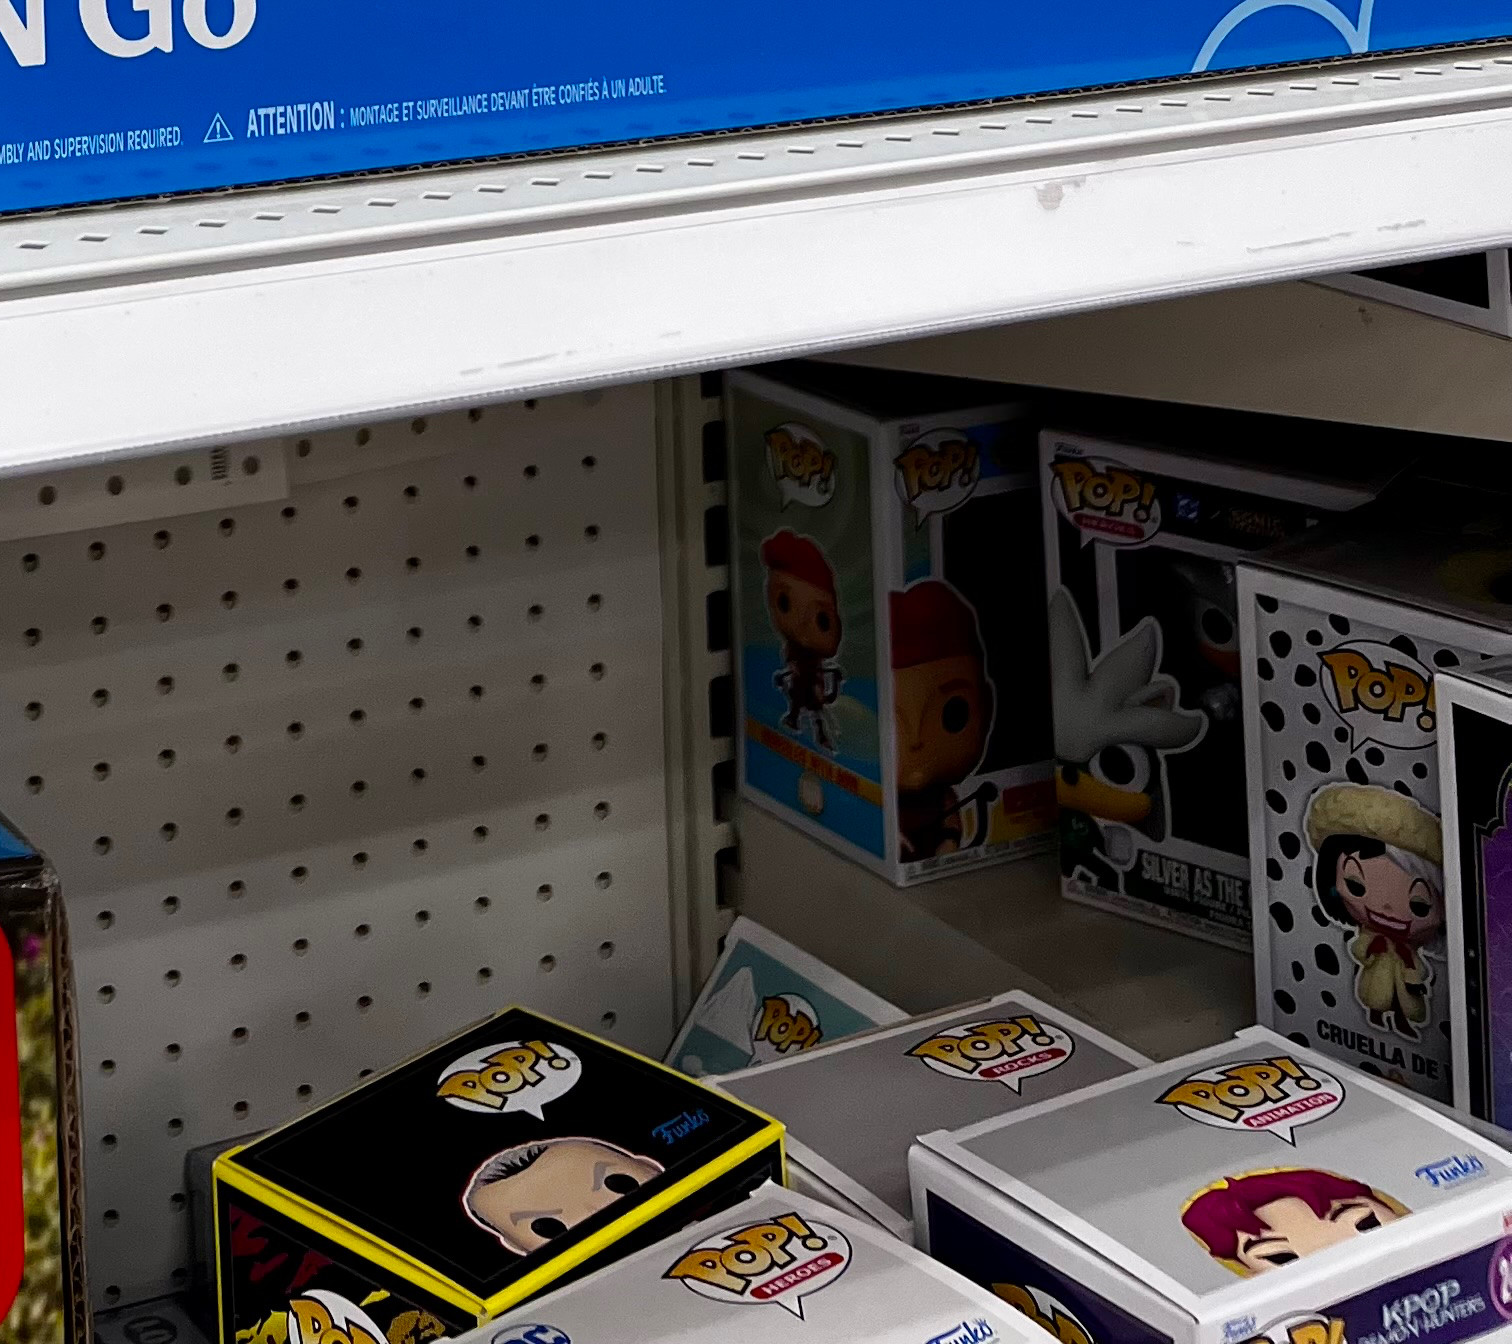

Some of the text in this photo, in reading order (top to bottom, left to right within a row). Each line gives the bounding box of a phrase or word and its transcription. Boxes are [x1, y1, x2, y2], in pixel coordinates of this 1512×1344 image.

[246, 100, 335, 138] ATTENTION
[349, 103, 400, 127] MONTAGE
[402, 102, 415, 123] ET
[416, 92, 489, 122] SURVEILLANCE
[490, 88, 530, 115] DEVANT
[610, 77, 626, 100] UN
[26, 139, 52, 164] AND
[53, 131, 124, 161] SUPERVISION
[893, 439, 979, 505] POP!
[1049, 459, 1157, 523] POP!
[1140, 851, 1189, 890] SILVER
[1193, 867, 1213, 898] AS
[1215, 873, 1244, 908] THE
[434, 1038, 572, 1111] POP!
[902, 1014, 1055, 1075] POP!
[992, 1049, 1054, 1076] ROCKS
[1316, 1019, 1407, 1069] CRUELLA
[1411, 1055, 1440, 1081] DE
[1154, 1055, 1322, 1123] POP!
[1248, 1093, 1335, 1129] ANIMATION
[661, 1211, 829, 1296] POP!
[762, 1255, 832, 1296] HEROES
